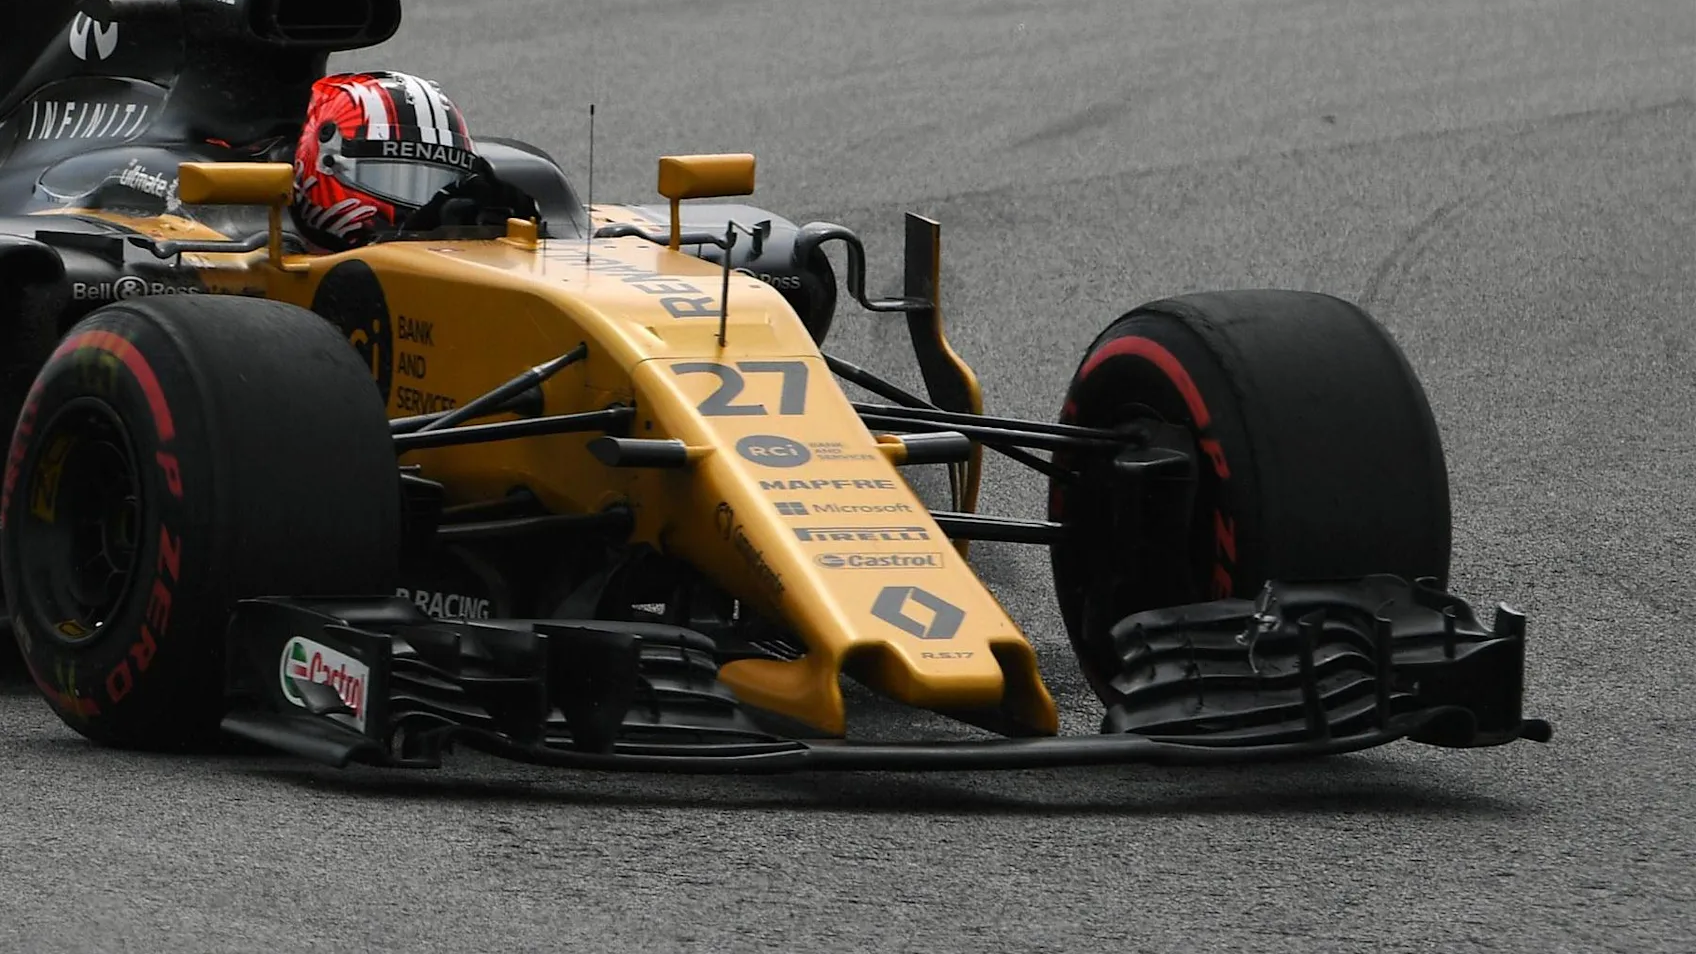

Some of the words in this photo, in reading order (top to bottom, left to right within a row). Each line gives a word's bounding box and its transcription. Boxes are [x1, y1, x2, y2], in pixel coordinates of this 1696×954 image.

[27, 101, 148, 140] INFINITI
[383, 141, 476, 170] RENAULT
[73, 282, 111, 300] Bell
[397, 315, 435, 346] BANK
[397, 351, 427, 380] AND
[670, 361, 809, 416] 27
[759, 479, 896, 490] MAPFRE
[812, 503, 912, 513] Microsoft
[792, 526, 931, 542] PIRELLI
[848, 554, 937, 567] Castrol
[106, 523, 182, 704] ZERO
[415, 590, 490, 620] RACING
